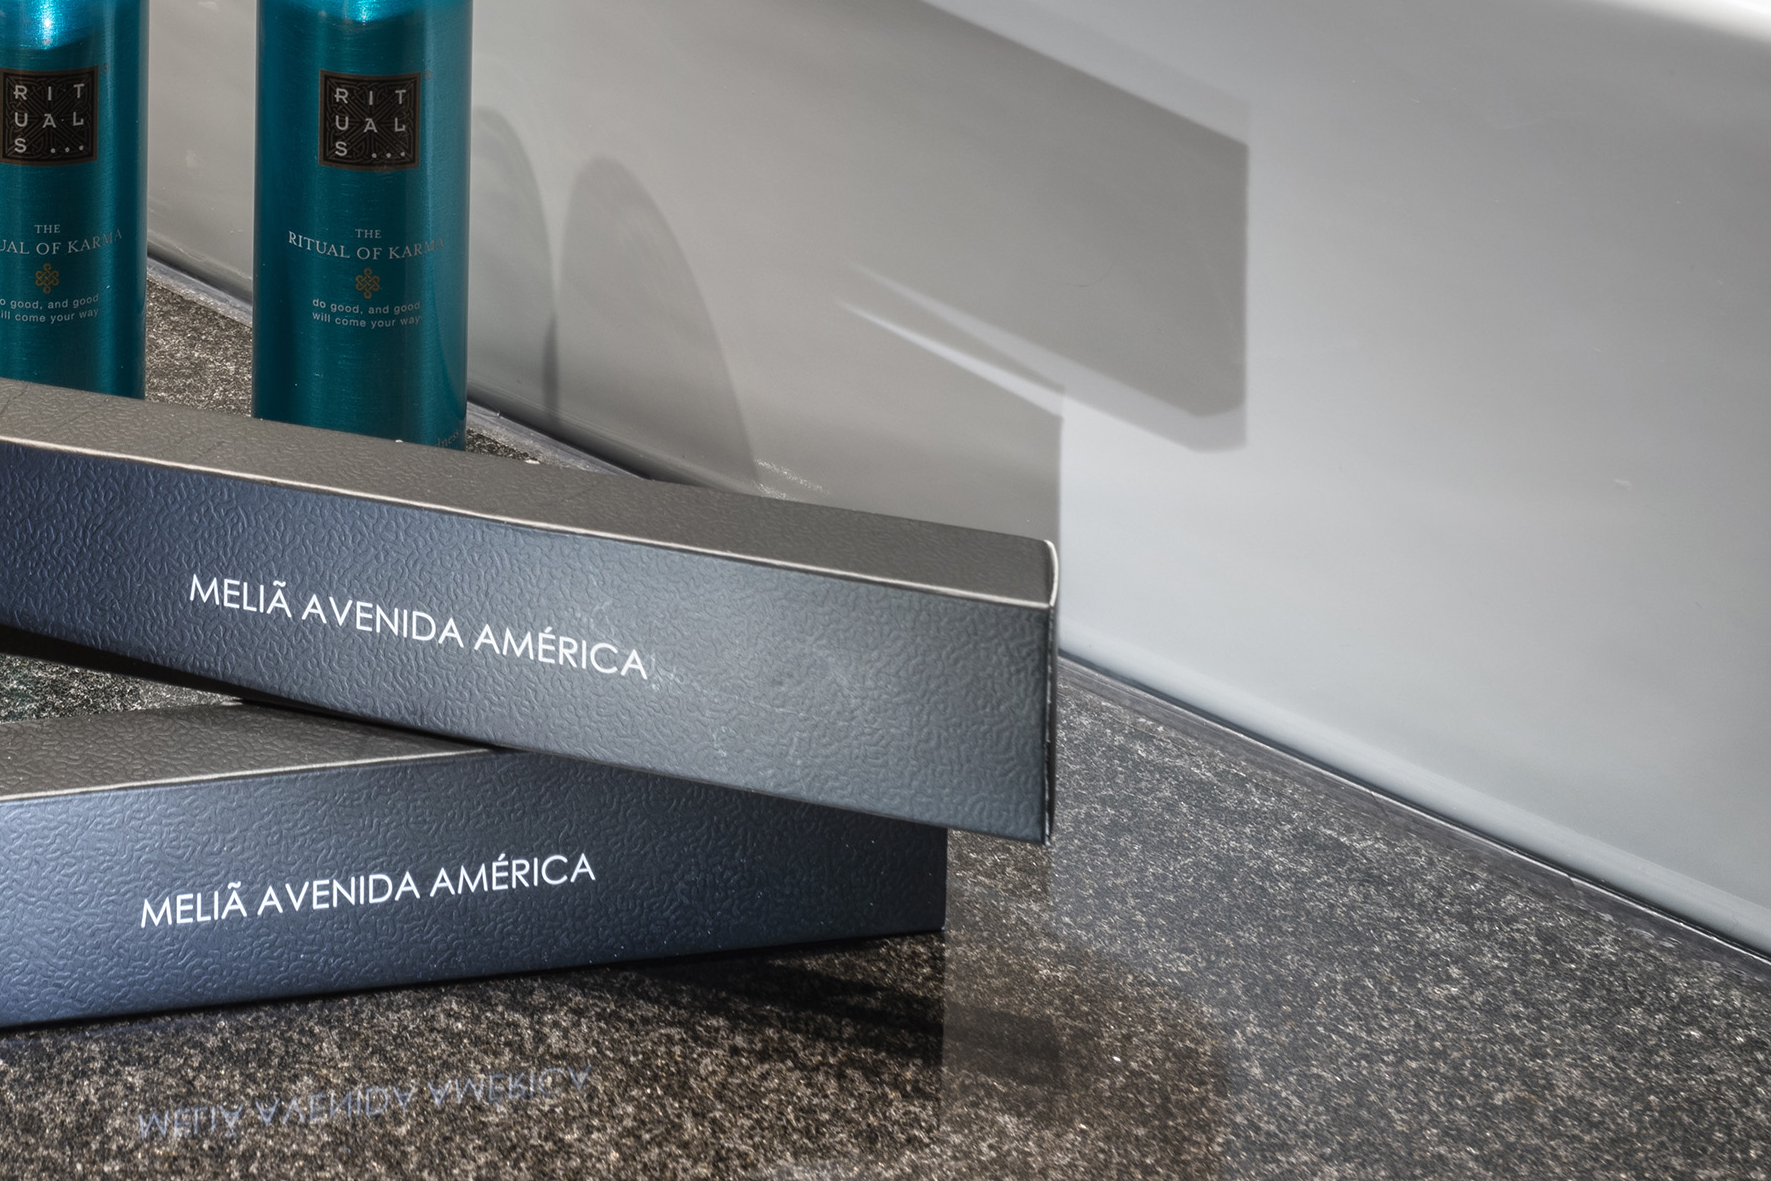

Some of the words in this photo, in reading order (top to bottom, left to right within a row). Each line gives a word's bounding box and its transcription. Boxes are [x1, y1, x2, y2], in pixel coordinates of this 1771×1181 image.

[34, 224, 61, 234] THE
[355, 228, 382, 239] THE
[36, 241, 62, 256] OF
[67, 229, 123, 254] KARMA
[288, 230, 350, 259] RITUAL
[356, 246, 383, 260] OF
[388, 237, 444, 260] KARMA
[10, 300, 43, 311] good,
[47, 299, 69, 309] and
[73, 293, 100, 309] good
[312, 298, 327, 309] do
[330, 302, 364, 314] good,
[368, 304, 390, 314] and
[394, 301, 421, 315] good
[14, 313, 46, 323] come
[50, 312, 76, 325] your
[79, 308, 100, 319] way
[312, 312, 331, 323] will
[335, 317, 367, 328] come
[371, 317, 396, 330] your
[400, 315, 421, 326] way
[302, 594, 464, 648] AVENIDA
[474, 623, 648, 680] AMÉRICA
[257, 870, 420, 916] AVENIDA
[429, 852, 596, 898] AMÉRICA
